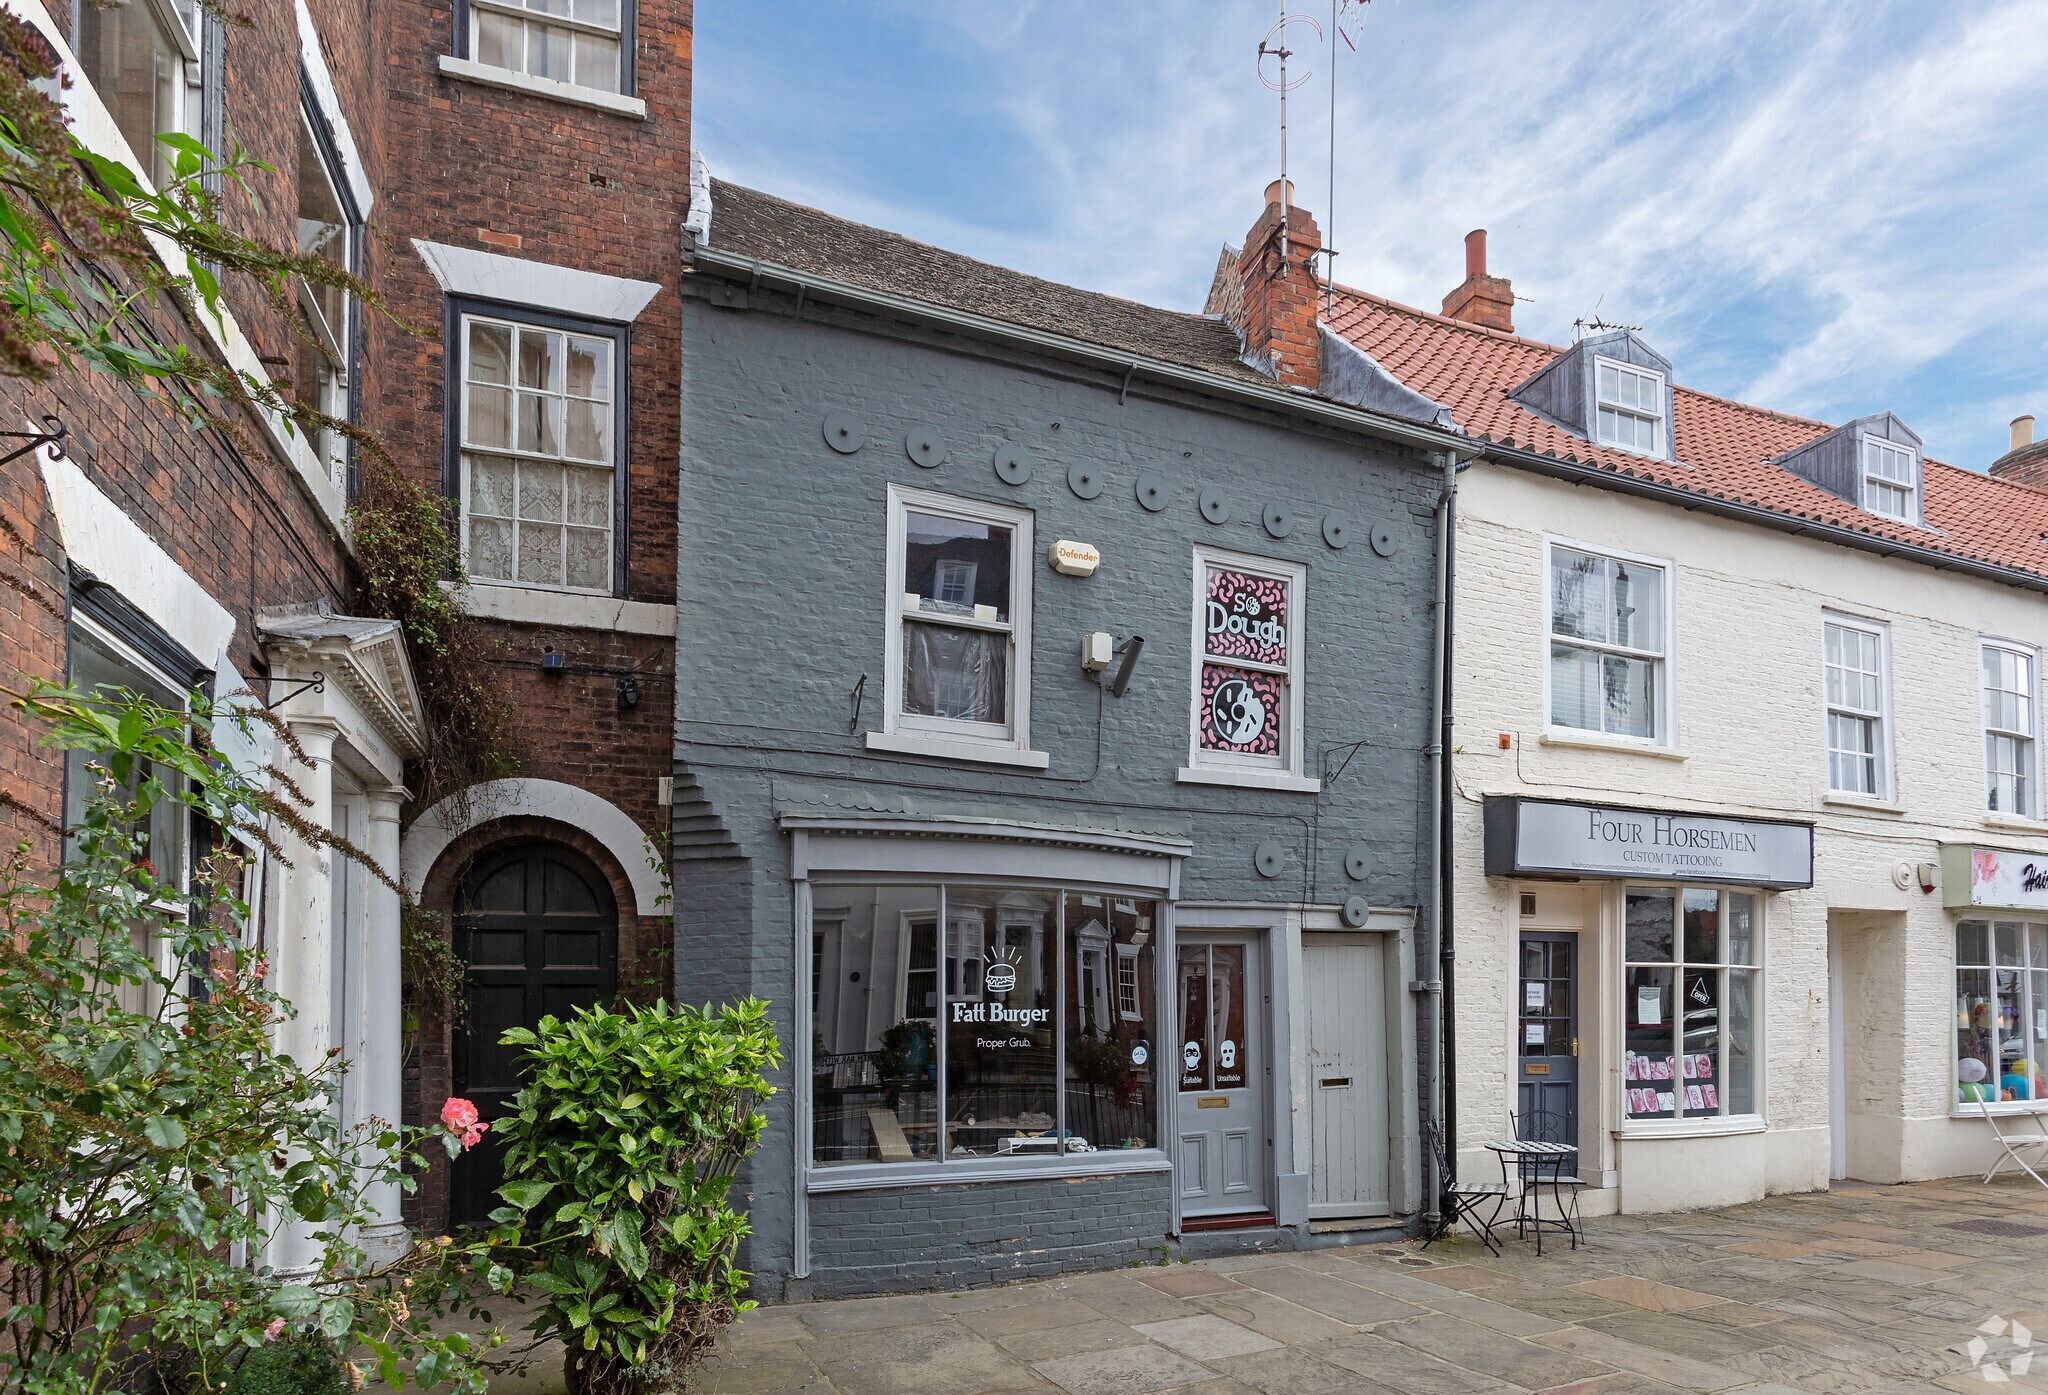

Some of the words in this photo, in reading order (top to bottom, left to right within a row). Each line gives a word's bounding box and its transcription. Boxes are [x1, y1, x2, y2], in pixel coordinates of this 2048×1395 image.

[1059, 548, 1098, 562] Defender
[1207, 600, 1286, 649] Dough
[1587, 809, 1643, 844] FOUR
[1651, 816, 1757, 853] HORSEMEN
[1622, 850, 1664, 864] CUSTOM
[1667, 853, 1723, 868] TATTOOING
[1694, 992, 1707, 1002] OPEN
[952, 1002, 986, 1023] Fatt
[989, 1002, 1050, 1028] Burger
[976, 1037, 1006, 1051] Proper
[1008, 1037, 1032, 1048] Grub.
[1183, 1076, 1203, 1084] Suitable
[1216, 1074, 1241, 1082] Unsuitable
